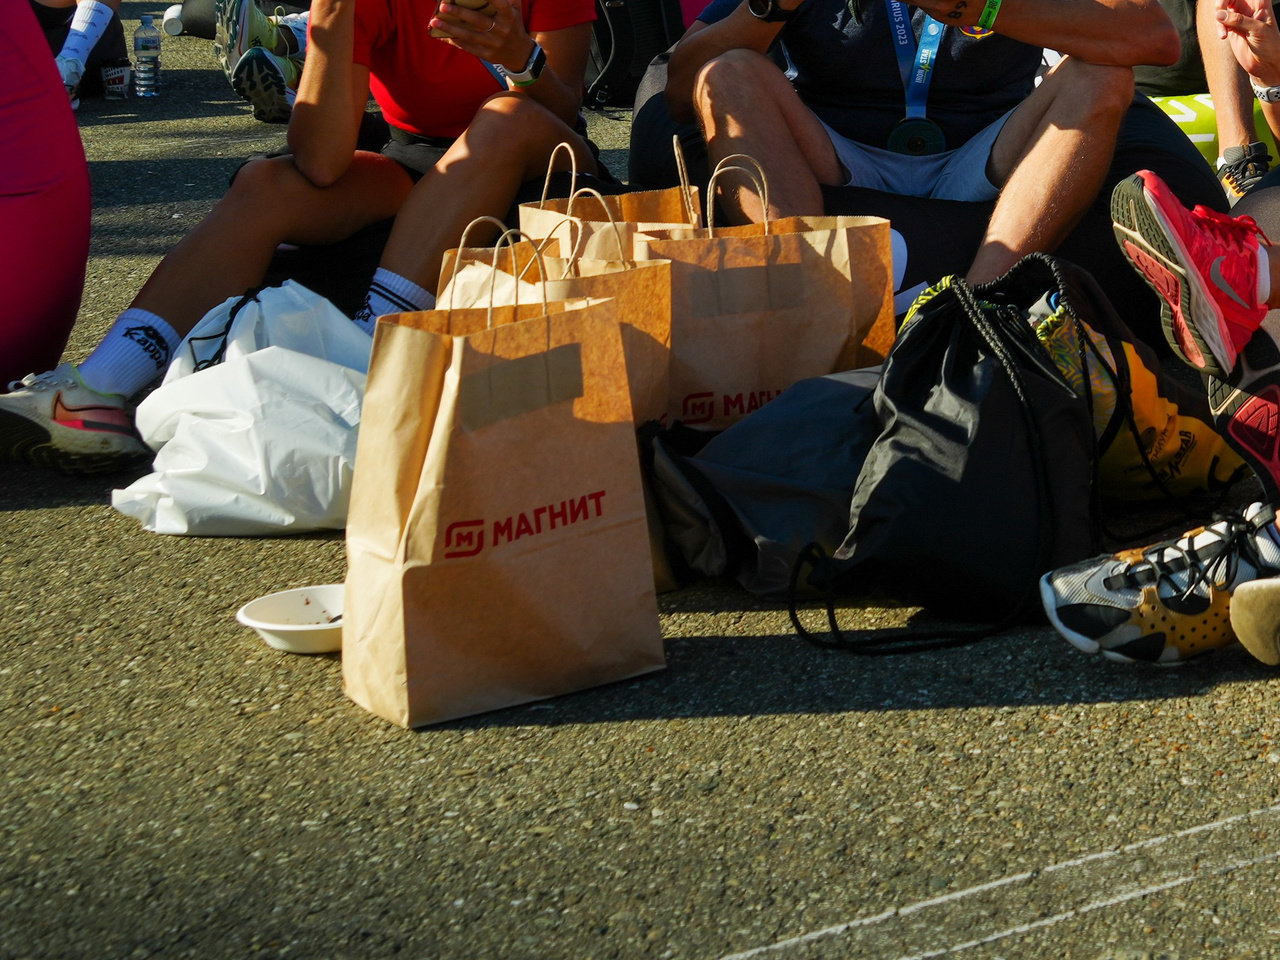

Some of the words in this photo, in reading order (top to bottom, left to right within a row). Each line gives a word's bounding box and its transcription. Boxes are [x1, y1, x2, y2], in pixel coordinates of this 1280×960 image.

[895, 23, 908, 45] 2023
[915, 68, 925, 83] IRON
[920, 49, 930, 64] STAR
[493, 490, 606, 547] МАГНИТ
